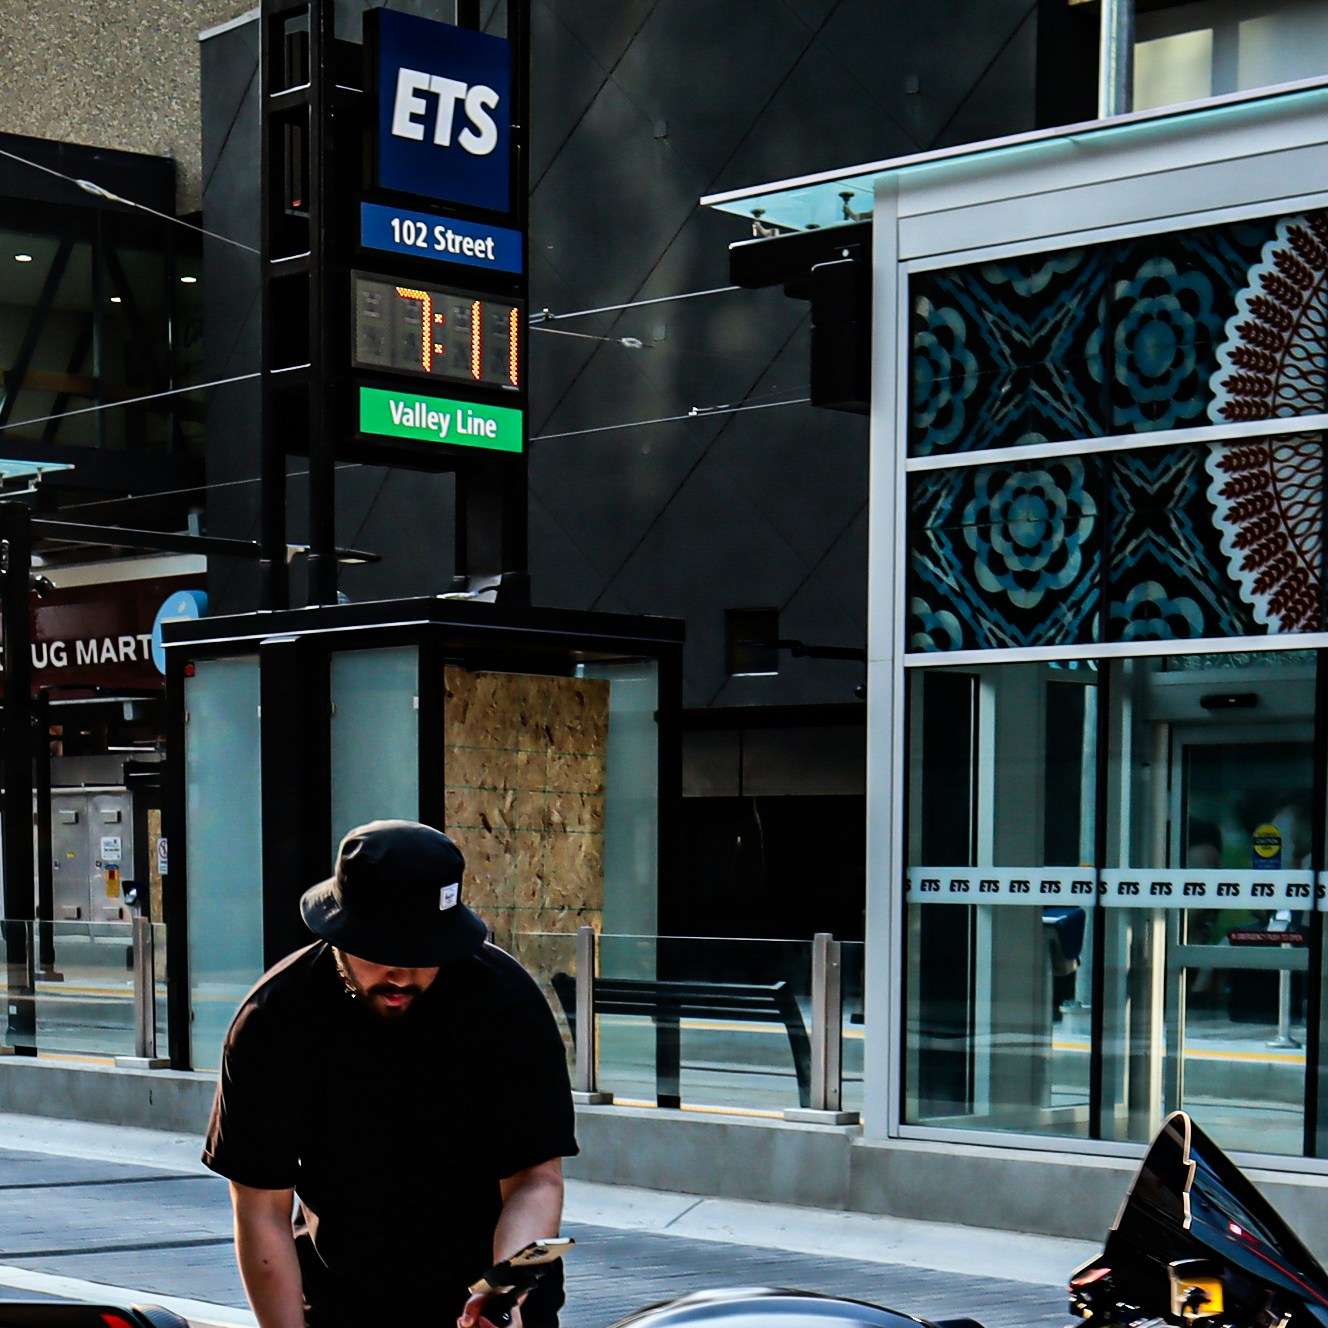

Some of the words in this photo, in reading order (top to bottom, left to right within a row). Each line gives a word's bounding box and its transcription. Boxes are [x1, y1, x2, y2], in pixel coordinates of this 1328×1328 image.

[391, 67, 500, 156] ETS
[390, 217, 428, 249] 102
[433, 225, 495, 261] Street
[395, 286, 519, 387] 7:11
[389, 400, 450, 439] Valley
[456, 408, 498, 439] Line
[75, 633, 153, 666] MART
[920, 879, 940, 892] ETS
[949, 880, 970, 892] ETS
[979, 880, 1000, 893] ETS
[1009, 880, 1030, 893] ETS
[1040, 880, 1061, 893] ETS
[1071, 881, 1093, 894] ETS
[1118, 882, 1139, 895] ETS
[1150, 882, 1172, 895] ETS
[1183, 883, 1206, 896] ETS
[1217, 883, 1240, 897] ETS
[1251, 883, 1274, 897] ETS
[1286, 884, 1310, 898] ETS
